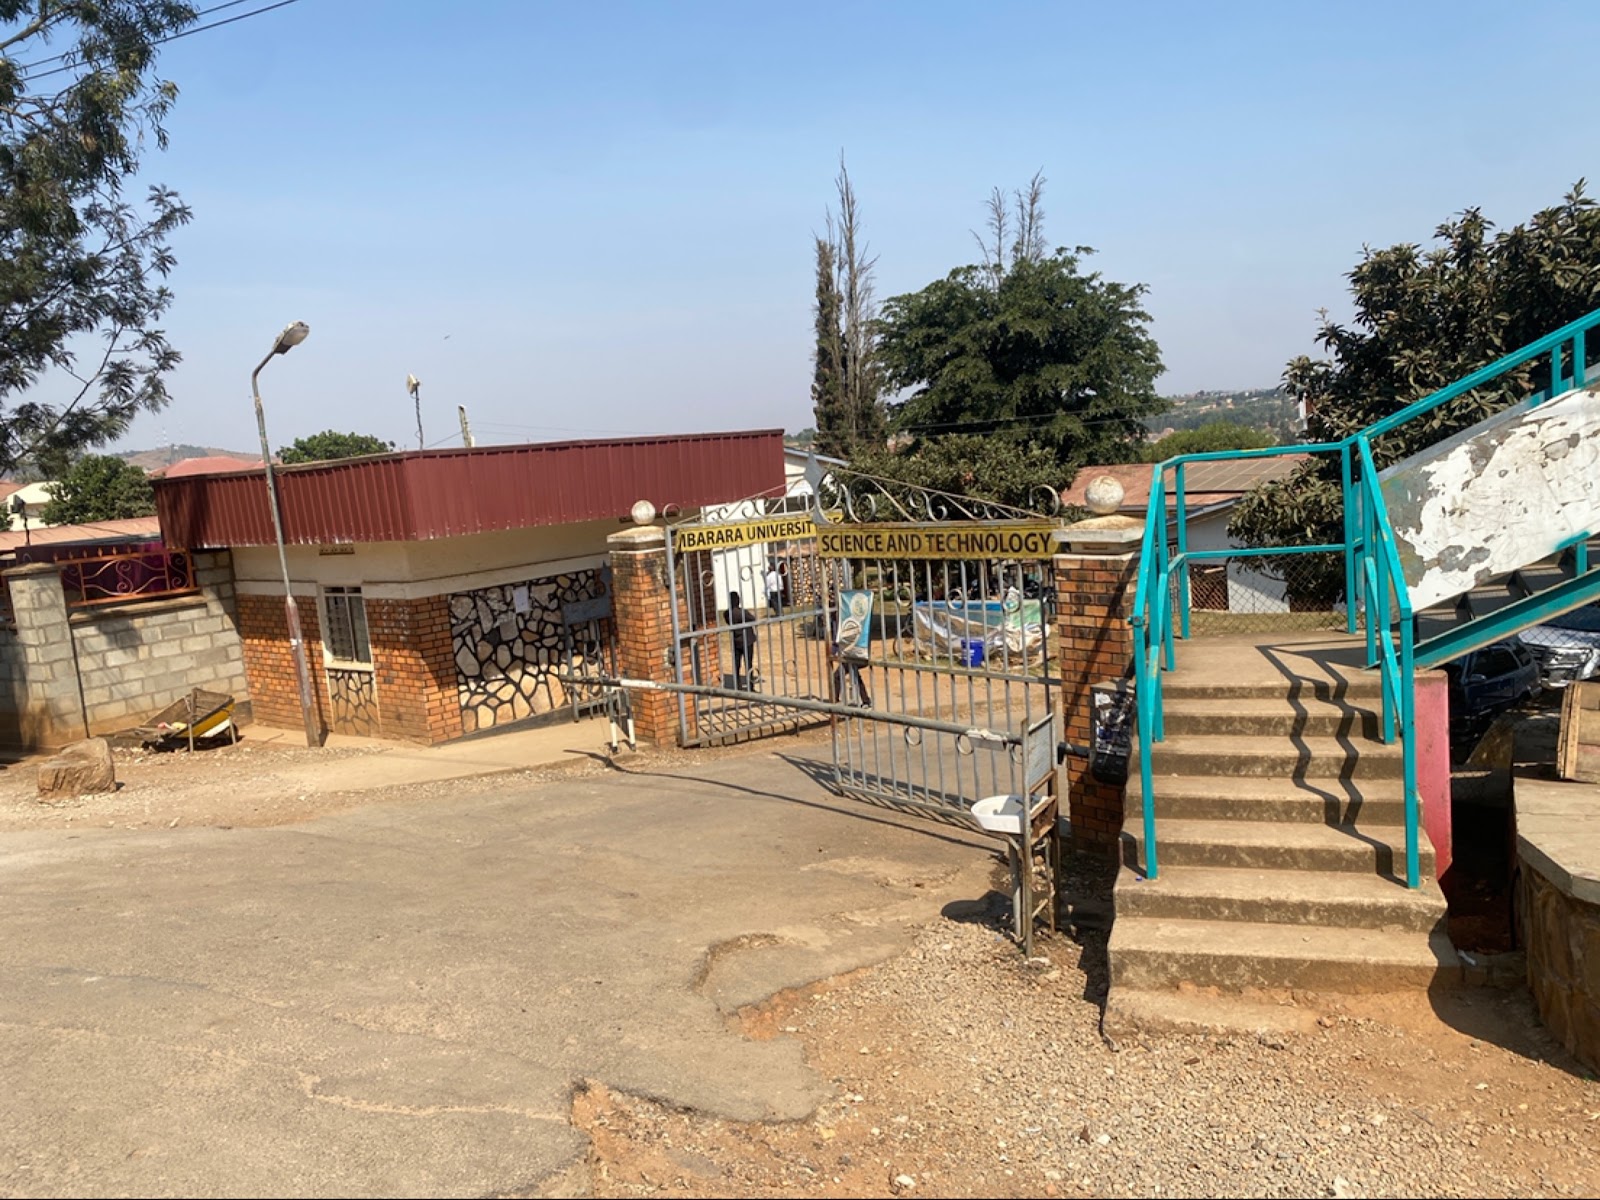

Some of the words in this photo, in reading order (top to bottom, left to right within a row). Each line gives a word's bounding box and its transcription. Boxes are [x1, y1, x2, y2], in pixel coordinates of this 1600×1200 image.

[747, 520, 813, 540] UNIVERSIT
[821, 534, 882, 551] SCIENCE
[886, 535, 921, 550] AND
[925, 533, 1051, 553] TECHNOLOGY
